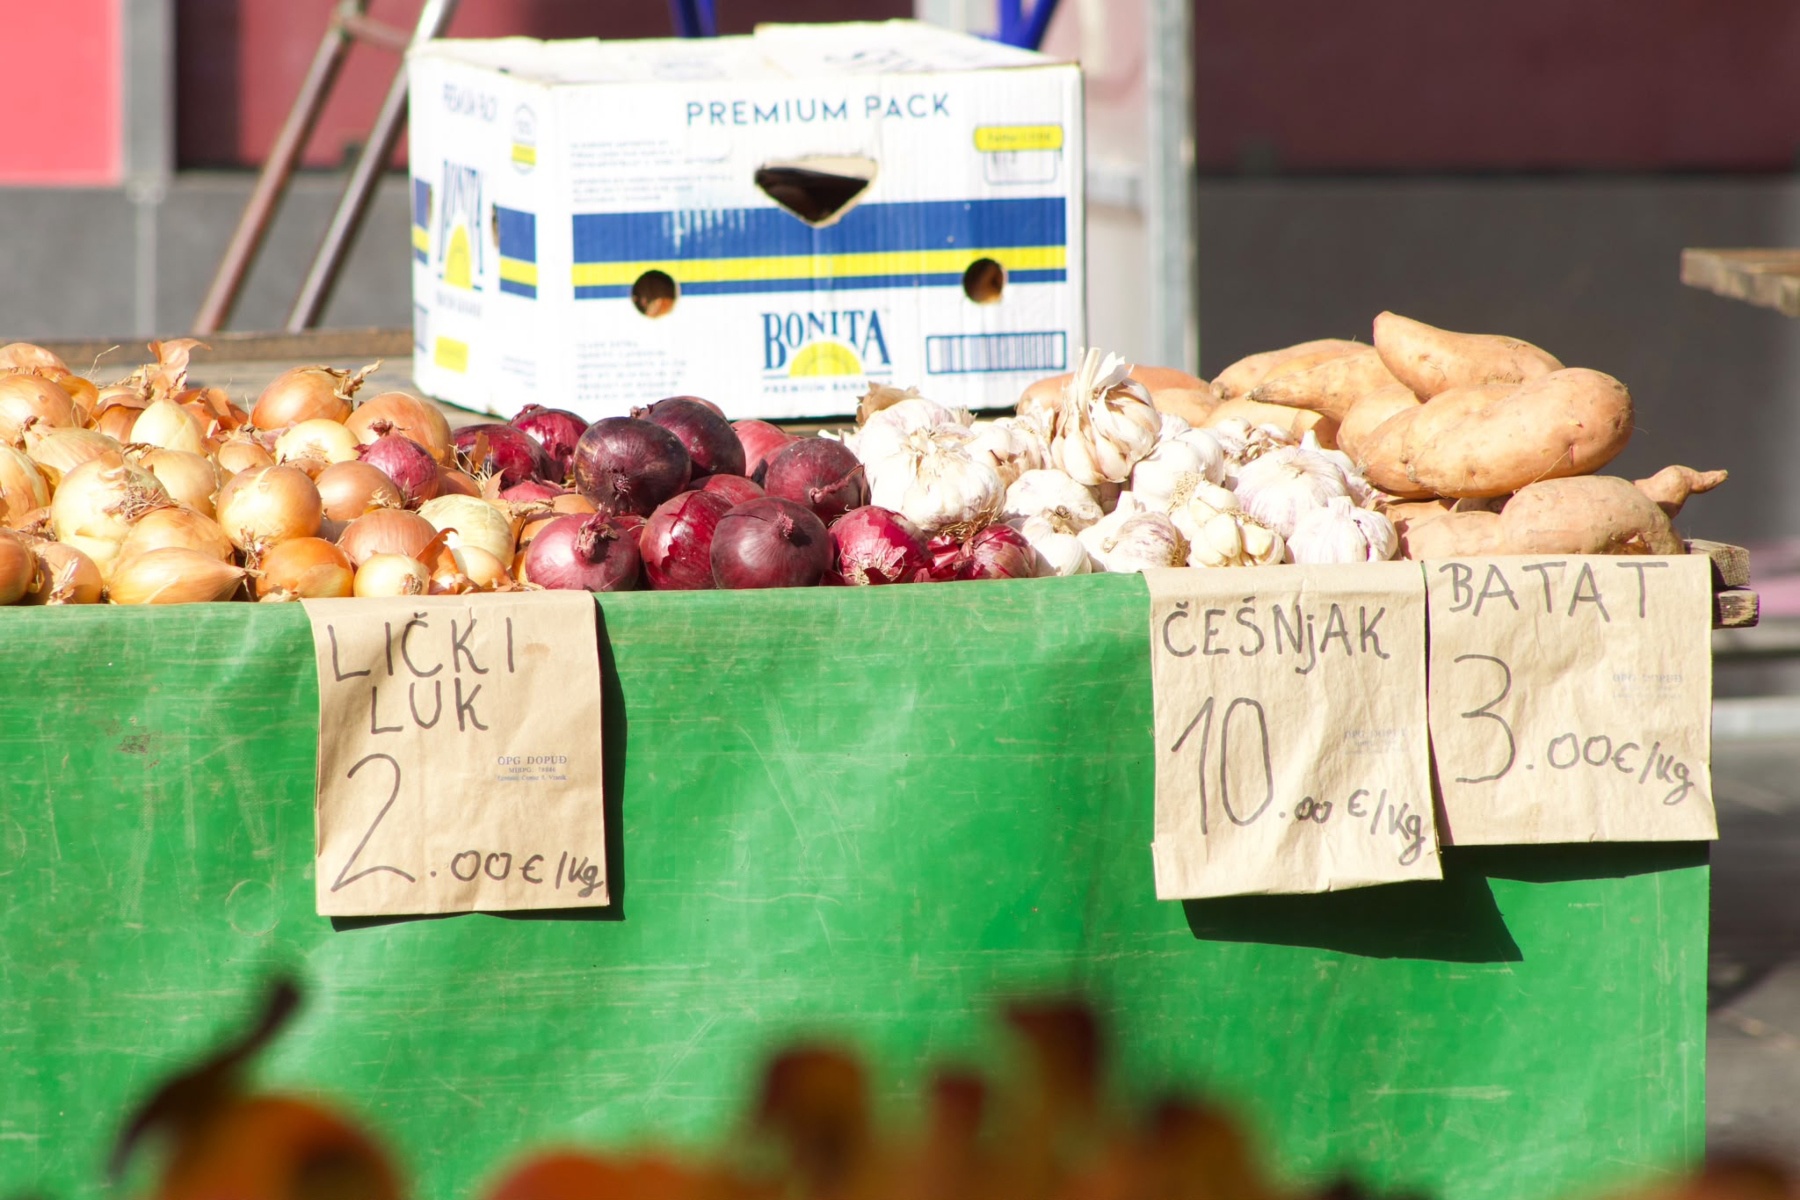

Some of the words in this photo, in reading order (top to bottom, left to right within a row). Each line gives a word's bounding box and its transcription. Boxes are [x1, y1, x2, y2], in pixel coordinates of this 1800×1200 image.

[686, 99, 847, 126] PREMIUM
[864, 92, 951, 119] PACK
[761, 309, 891, 370] BONITA
[1438, 561, 1669, 623] BATAT
[327, 612, 515, 682] LIČKI
[371, 677, 489, 735] LUK
[497, 756, 521, 765] OPG
